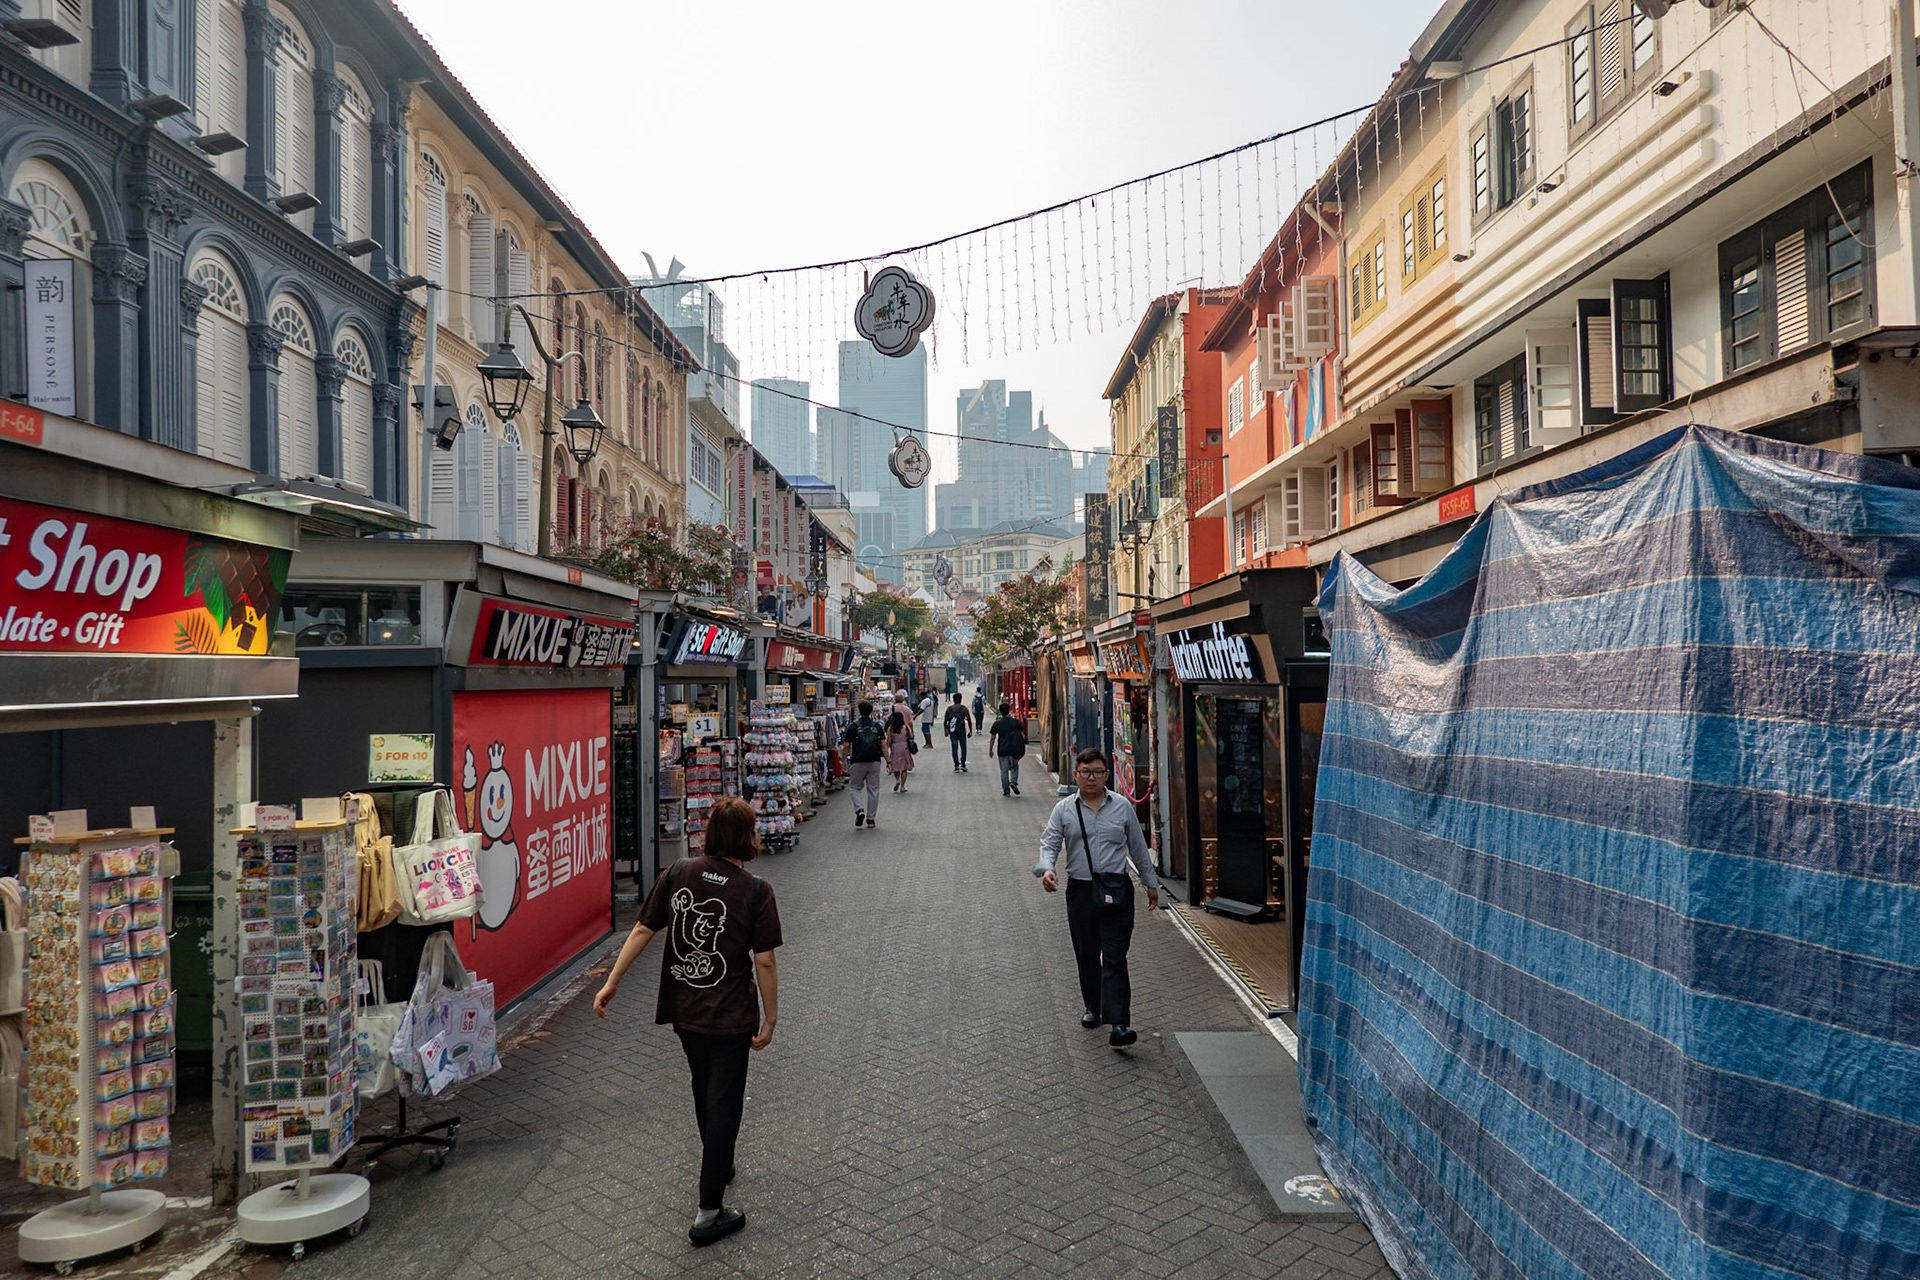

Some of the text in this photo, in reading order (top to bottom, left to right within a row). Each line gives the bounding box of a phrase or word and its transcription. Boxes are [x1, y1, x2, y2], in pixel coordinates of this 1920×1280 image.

[35, 275, 64, 303] 韵
[45, 315, 59, 389] PERSONÉ
[738, 454, 746, 489] CHINATOWN
[1442, 494, 1470, 518] PSSF-65
[15, 519, 162, 611] Shop
[0, 606, 125, 648] late Gift
[493, 610, 573, 663] MIXUE
[690, 624, 710, 652] SG
[1166, 629, 1207, 679] luckin
[1203, 621, 1253, 679] coffee
[695, 718, 712, 732] $1
[375, 752, 382, 761] 5
[385, 752, 409, 761] FOR
[525, 736, 607, 818] MIXUE
[413, 858, 446, 876] LION
[526, 803, 608, 901] 蜜雪冰城
[702, 870, 729, 885] nakey
[462, 1021, 474, 1031] SG
